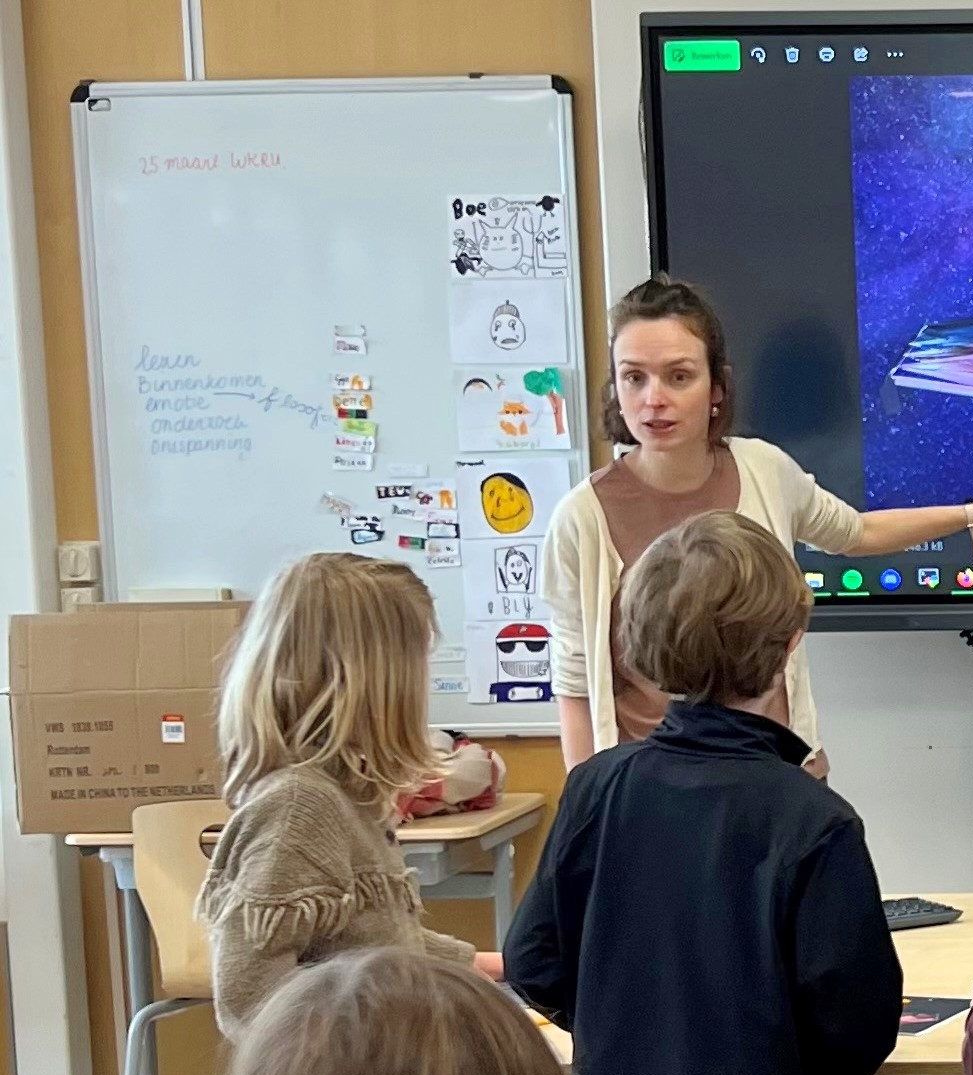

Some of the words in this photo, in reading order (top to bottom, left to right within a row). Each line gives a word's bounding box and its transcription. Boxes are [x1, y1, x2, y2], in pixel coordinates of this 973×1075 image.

[139, 156, 158, 175] 25
[452, 198, 487, 220] Boe
[51, 789, 76, 800] MADE
[77, 788, 87, 799] IN
[89, 787, 115, 799] CHINA
[117, 787, 129, 798] TO
[131, 786, 149, 797] THE
[150, 784, 216, 796] NETHERLANDS
